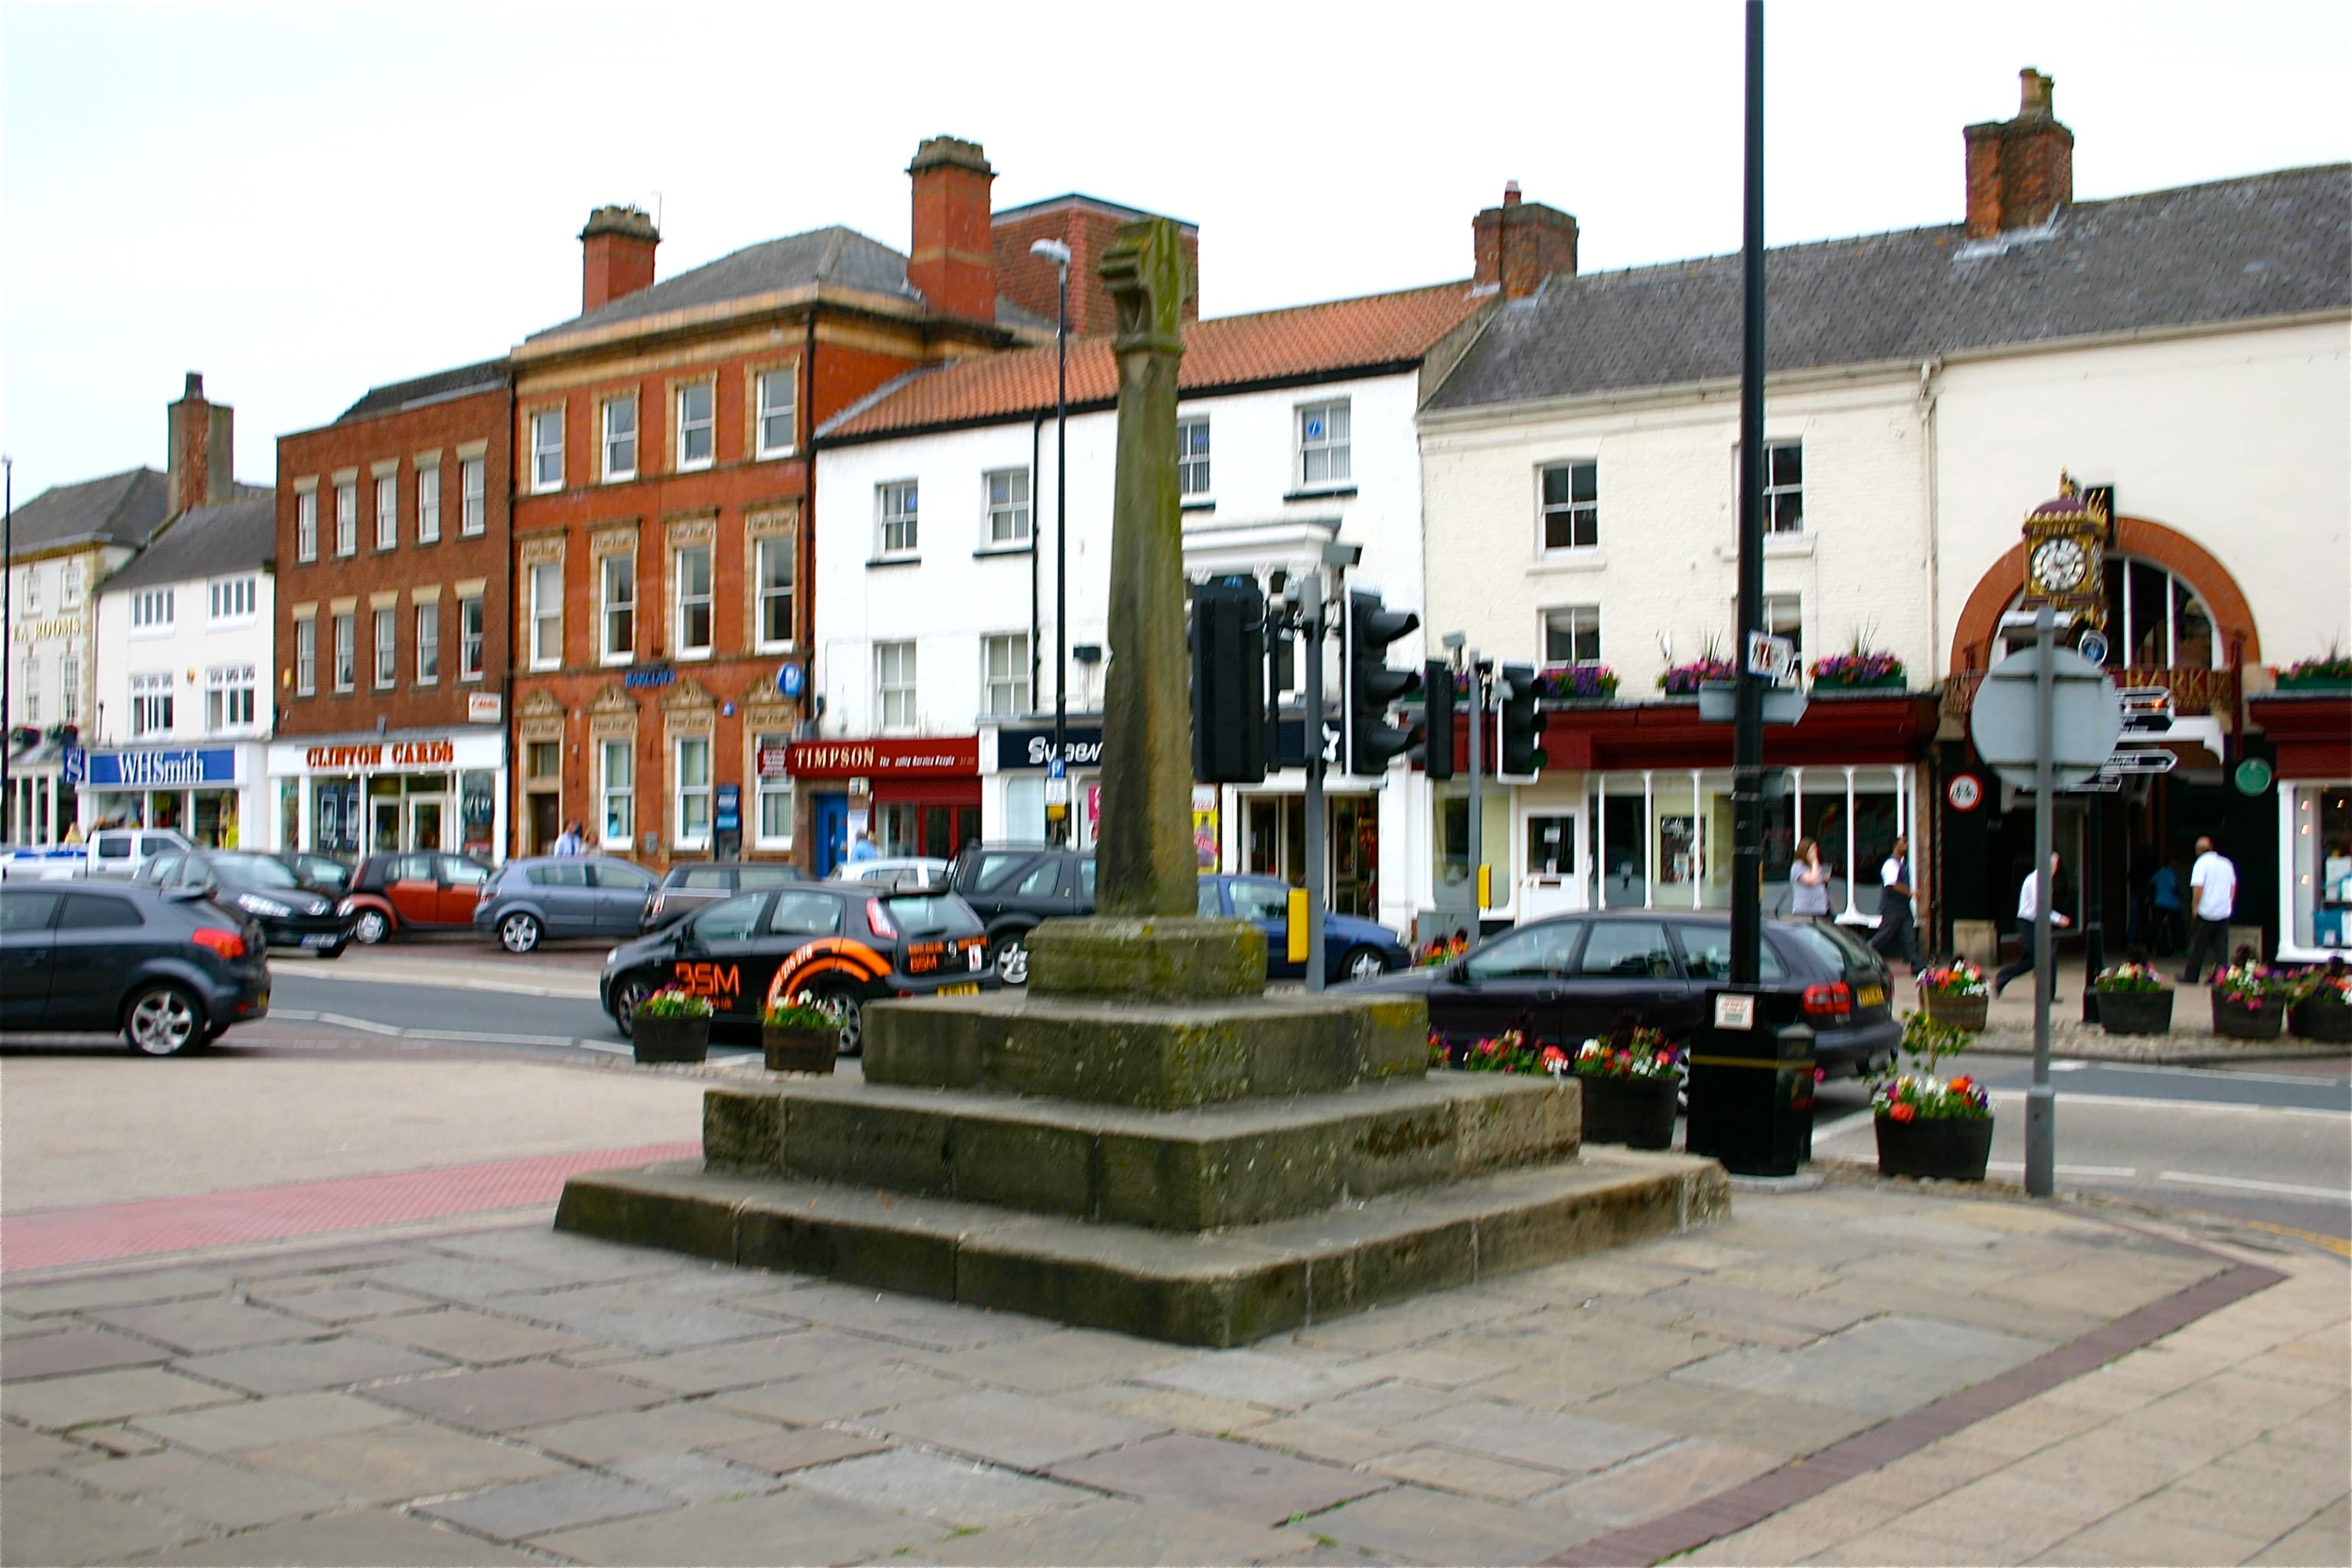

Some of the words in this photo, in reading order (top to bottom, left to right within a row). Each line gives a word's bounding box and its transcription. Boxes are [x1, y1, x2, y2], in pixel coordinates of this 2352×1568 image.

[626, 669, 675, 688] BARCLAYS
[118, 748, 204, 786] WHSmith
[307, 746, 382, 768] CLINTON
[392, 739, 453, 765] CARDS
[795, 746, 874, 769] TIMPSON
[675, 962, 740, 998] BSM
